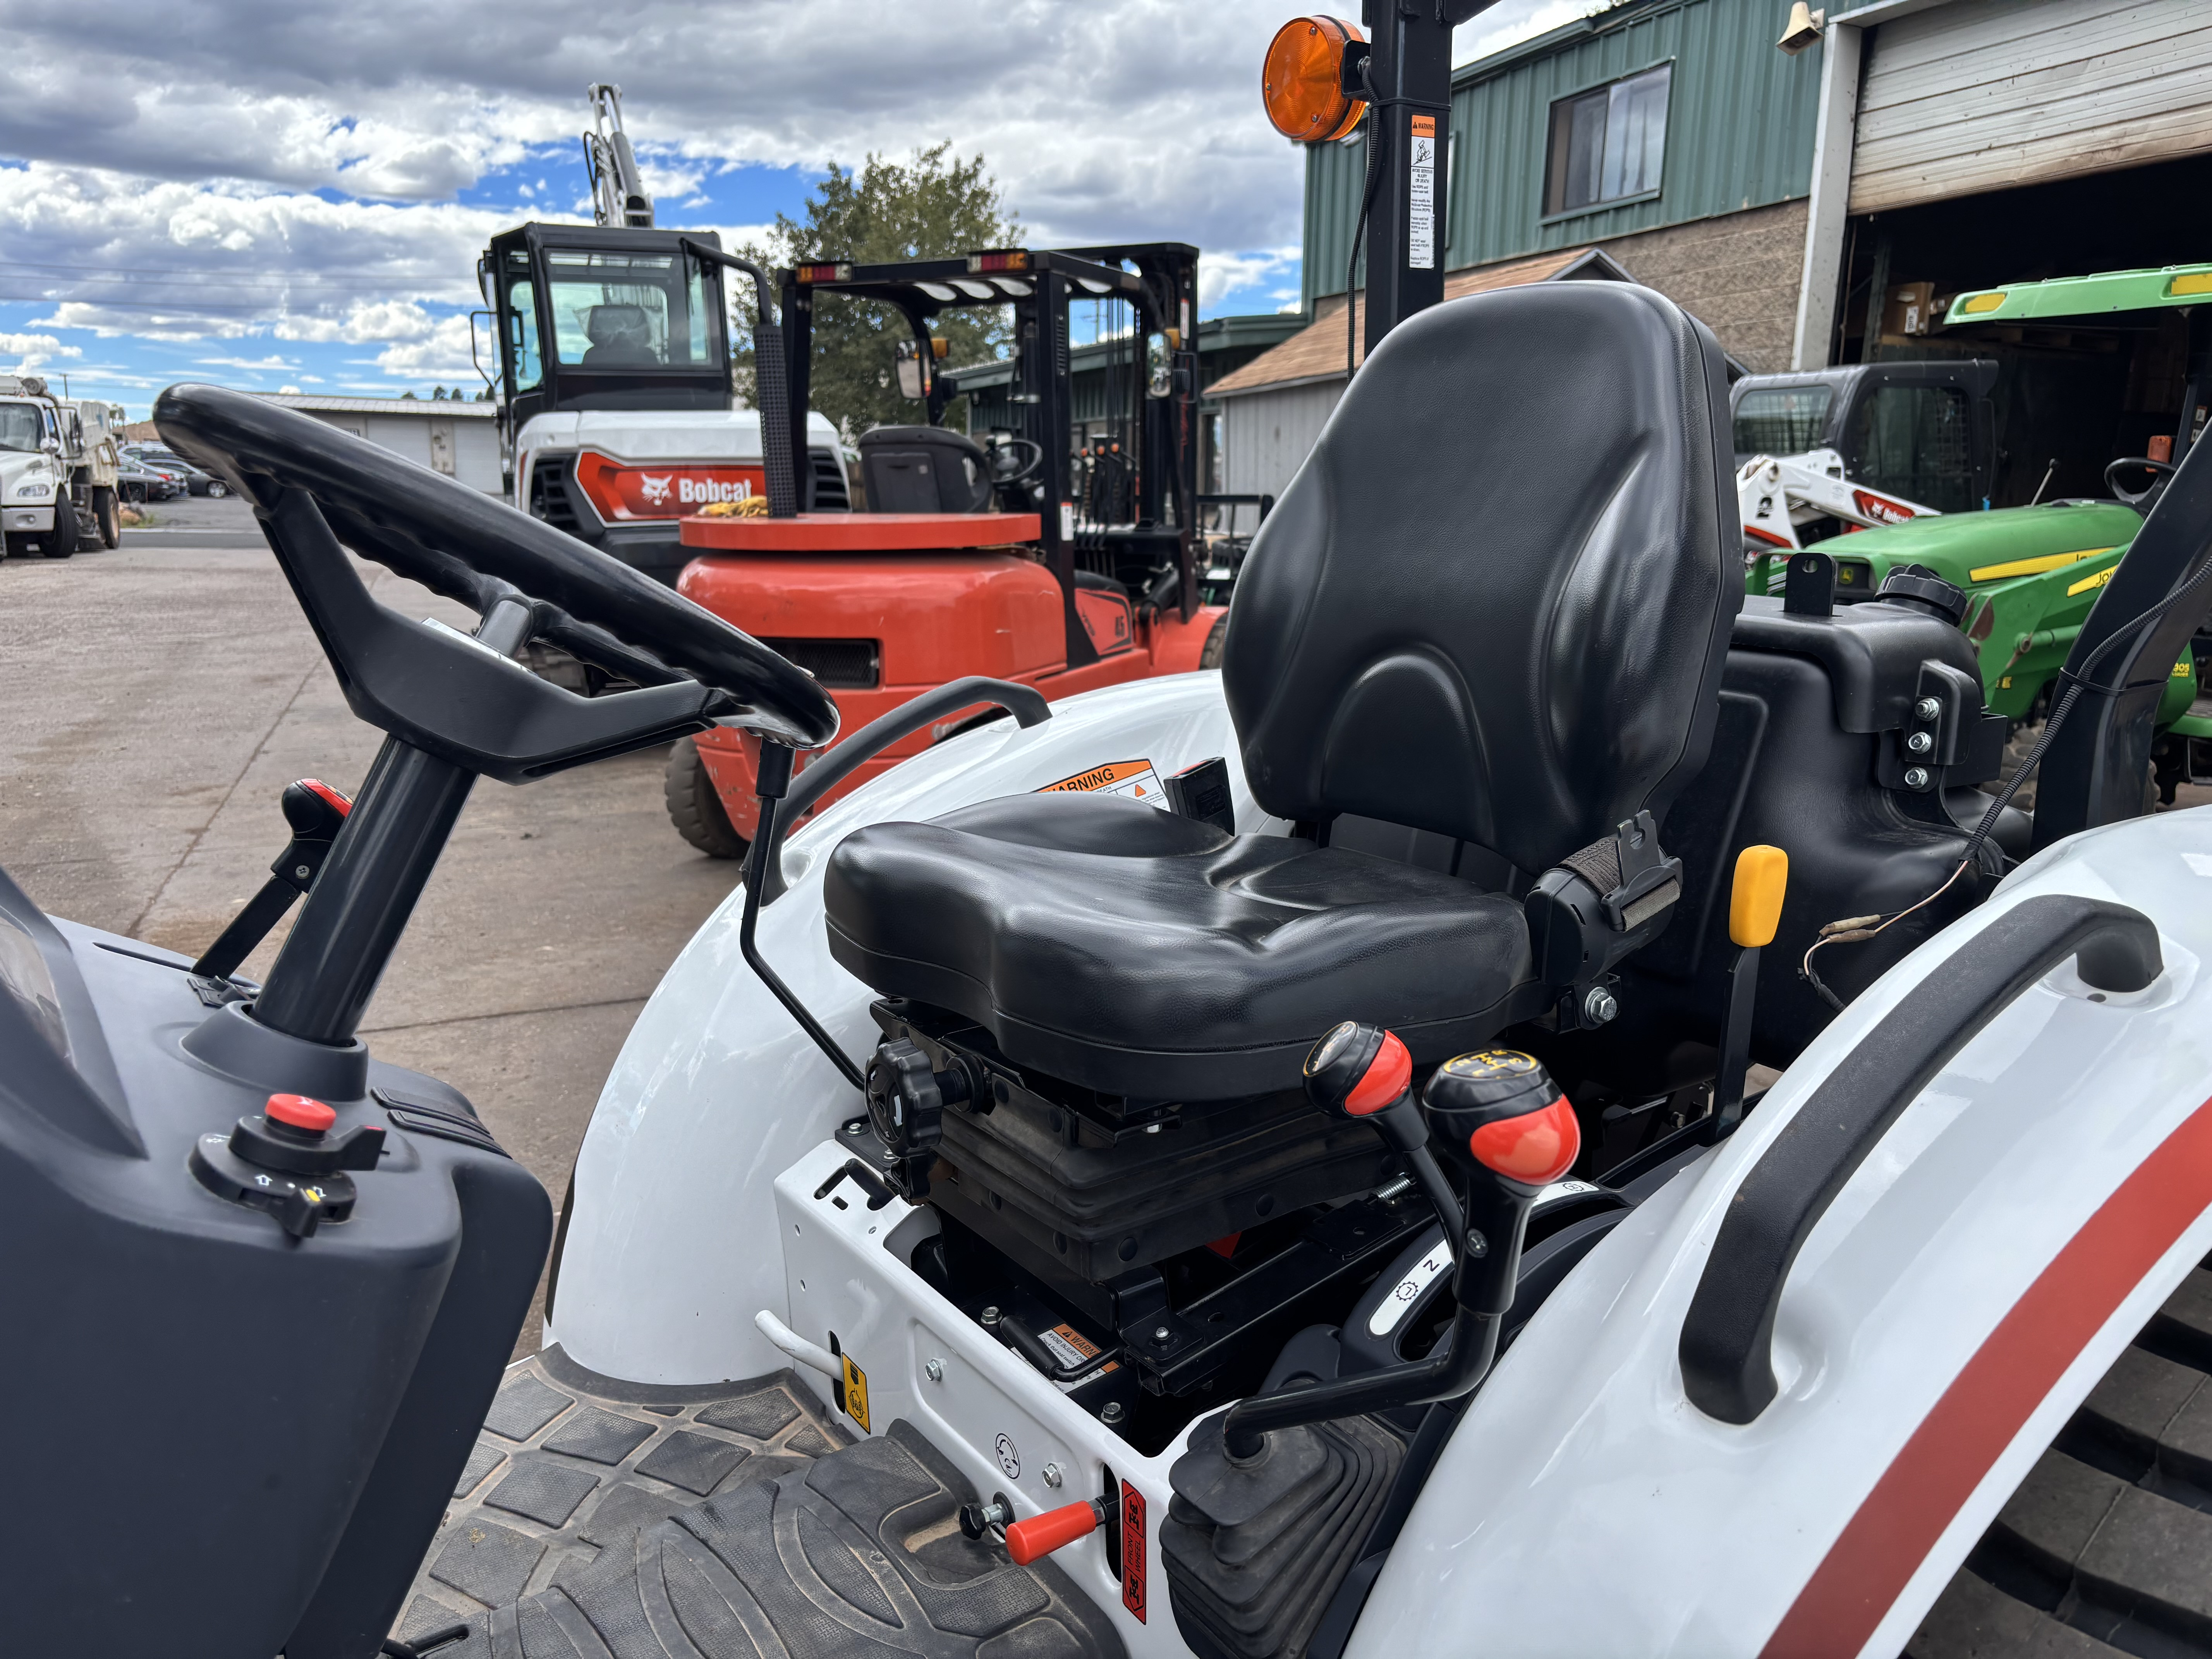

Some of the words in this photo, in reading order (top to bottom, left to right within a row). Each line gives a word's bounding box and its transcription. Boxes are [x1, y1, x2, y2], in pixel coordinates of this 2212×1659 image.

[679, 477, 752, 503] Bobcat
[1048, 768, 1115, 792] ARNING
[1423, 1259, 1440, 1272] N
[1047, 1333, 1063, 1345] AVOID
[1060, 1342, 1079, 1358] INJURY
[1070, 1336, 1097, 1357] WARNI
